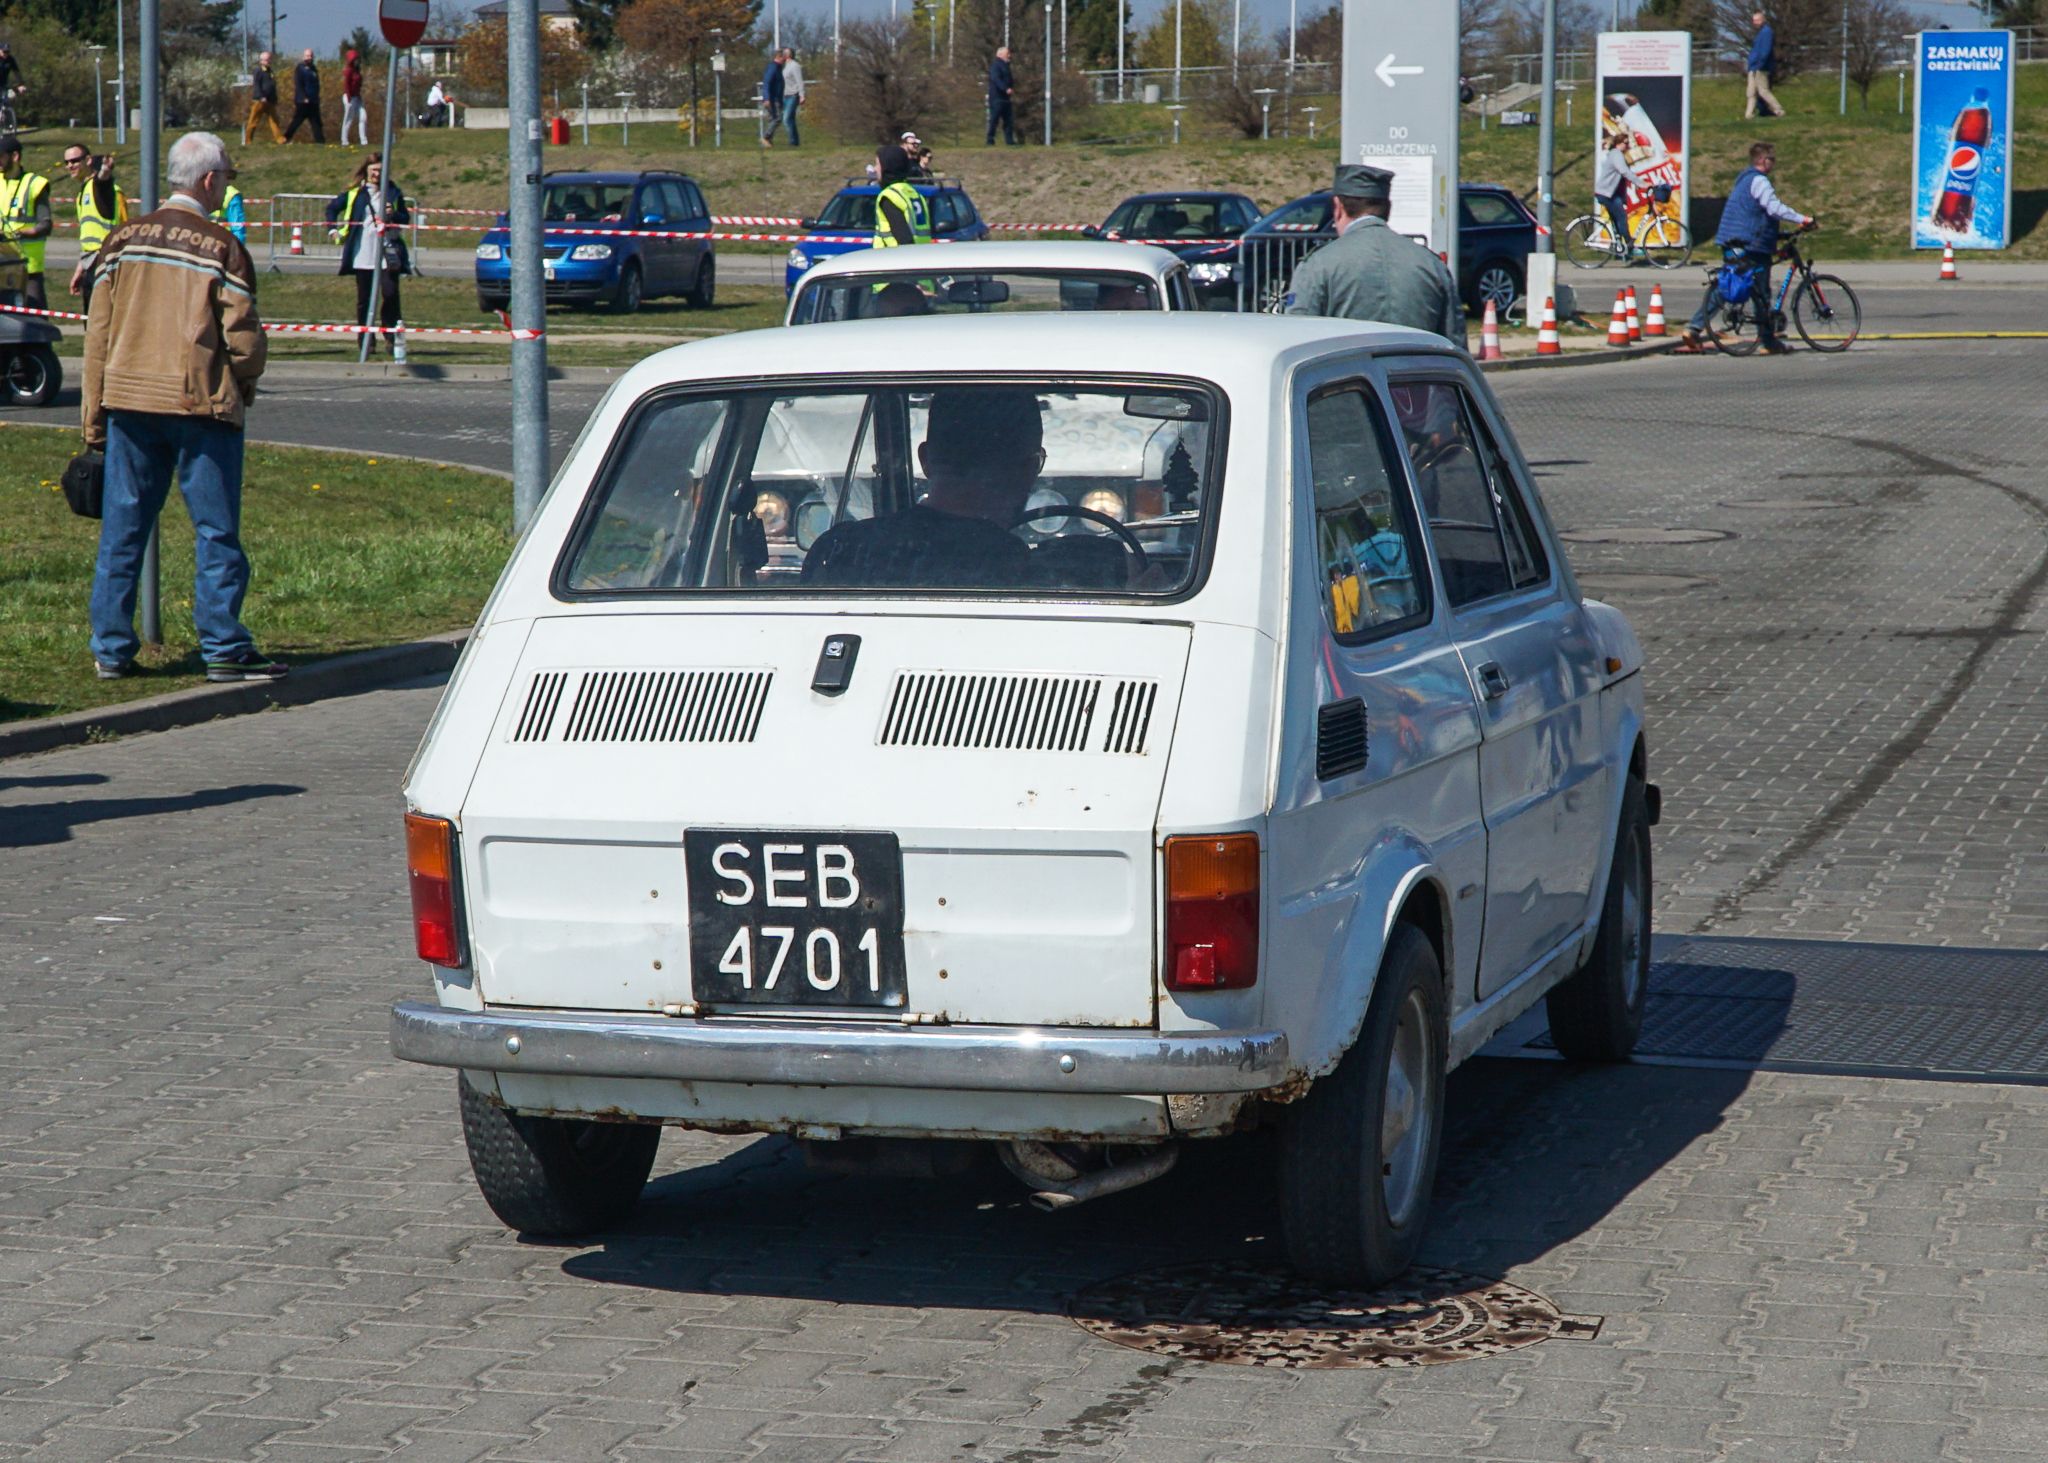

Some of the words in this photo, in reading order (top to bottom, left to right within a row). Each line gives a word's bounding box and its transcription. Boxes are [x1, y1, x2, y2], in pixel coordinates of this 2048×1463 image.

[1927, 46, 2003, 62] ZASMAKUJ
[1390, 126, 1408, 138] DO
[1359, 143, 1437, 155] ZOBACZENIA
[110, 223, 163, 245] MOTOR
[167, 226, 228, 253] SPORT
[711, 842, 860, 908] SEB
[718, 925, 879, 992] 4701
